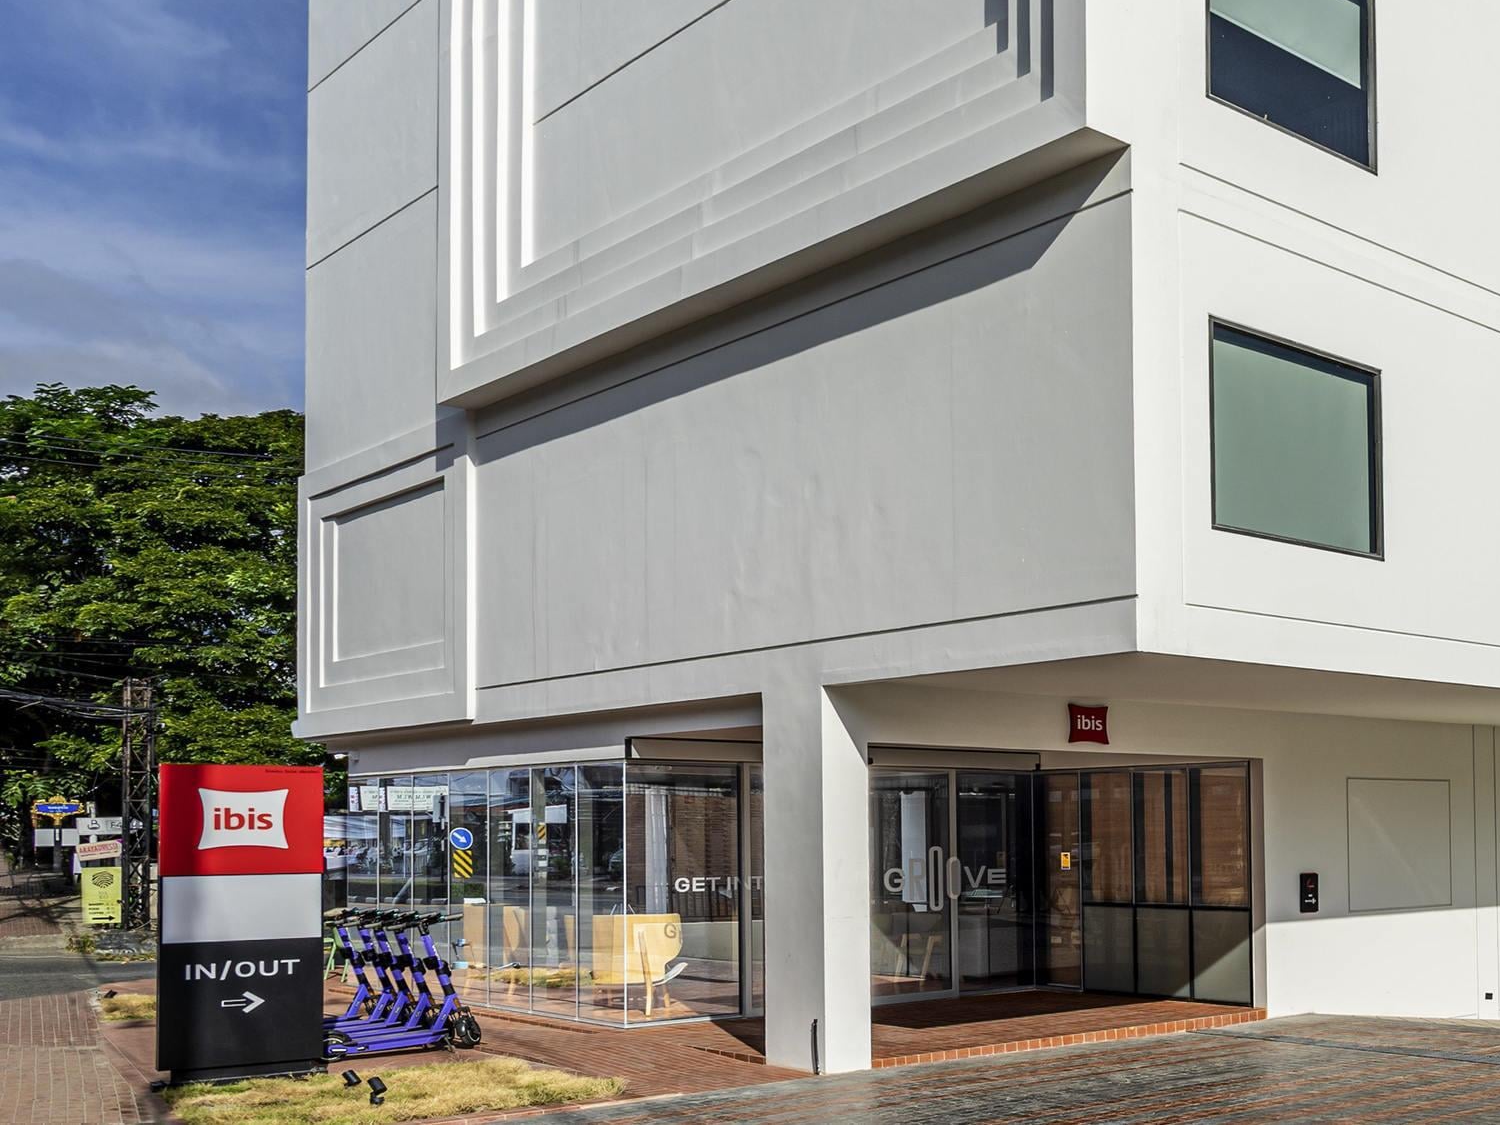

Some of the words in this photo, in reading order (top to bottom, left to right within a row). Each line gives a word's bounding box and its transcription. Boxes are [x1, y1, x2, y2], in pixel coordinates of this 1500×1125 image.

[1077, 715, 1103, 731] ibis
[213, 807, 273, 831] ibis
[674, 876, 721, 893] GET
[184, 958, 301, 981] IN/OUT
